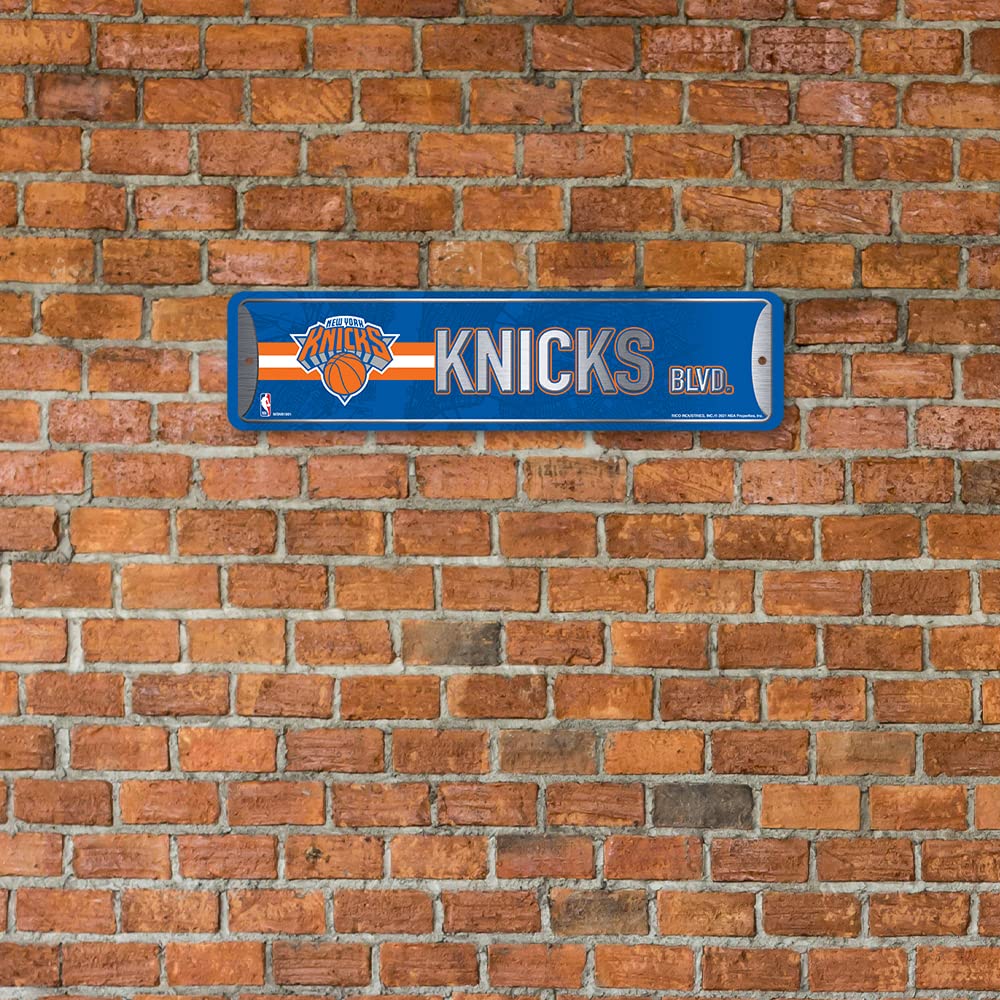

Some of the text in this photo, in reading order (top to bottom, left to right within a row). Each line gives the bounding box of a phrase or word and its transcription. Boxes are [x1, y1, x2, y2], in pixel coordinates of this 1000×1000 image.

[326, 318, 365, 328] NEW YORK
[298, 326, 393, 363] KNICKS
[434, 327, 734, 395] KNICKS BLVD.
